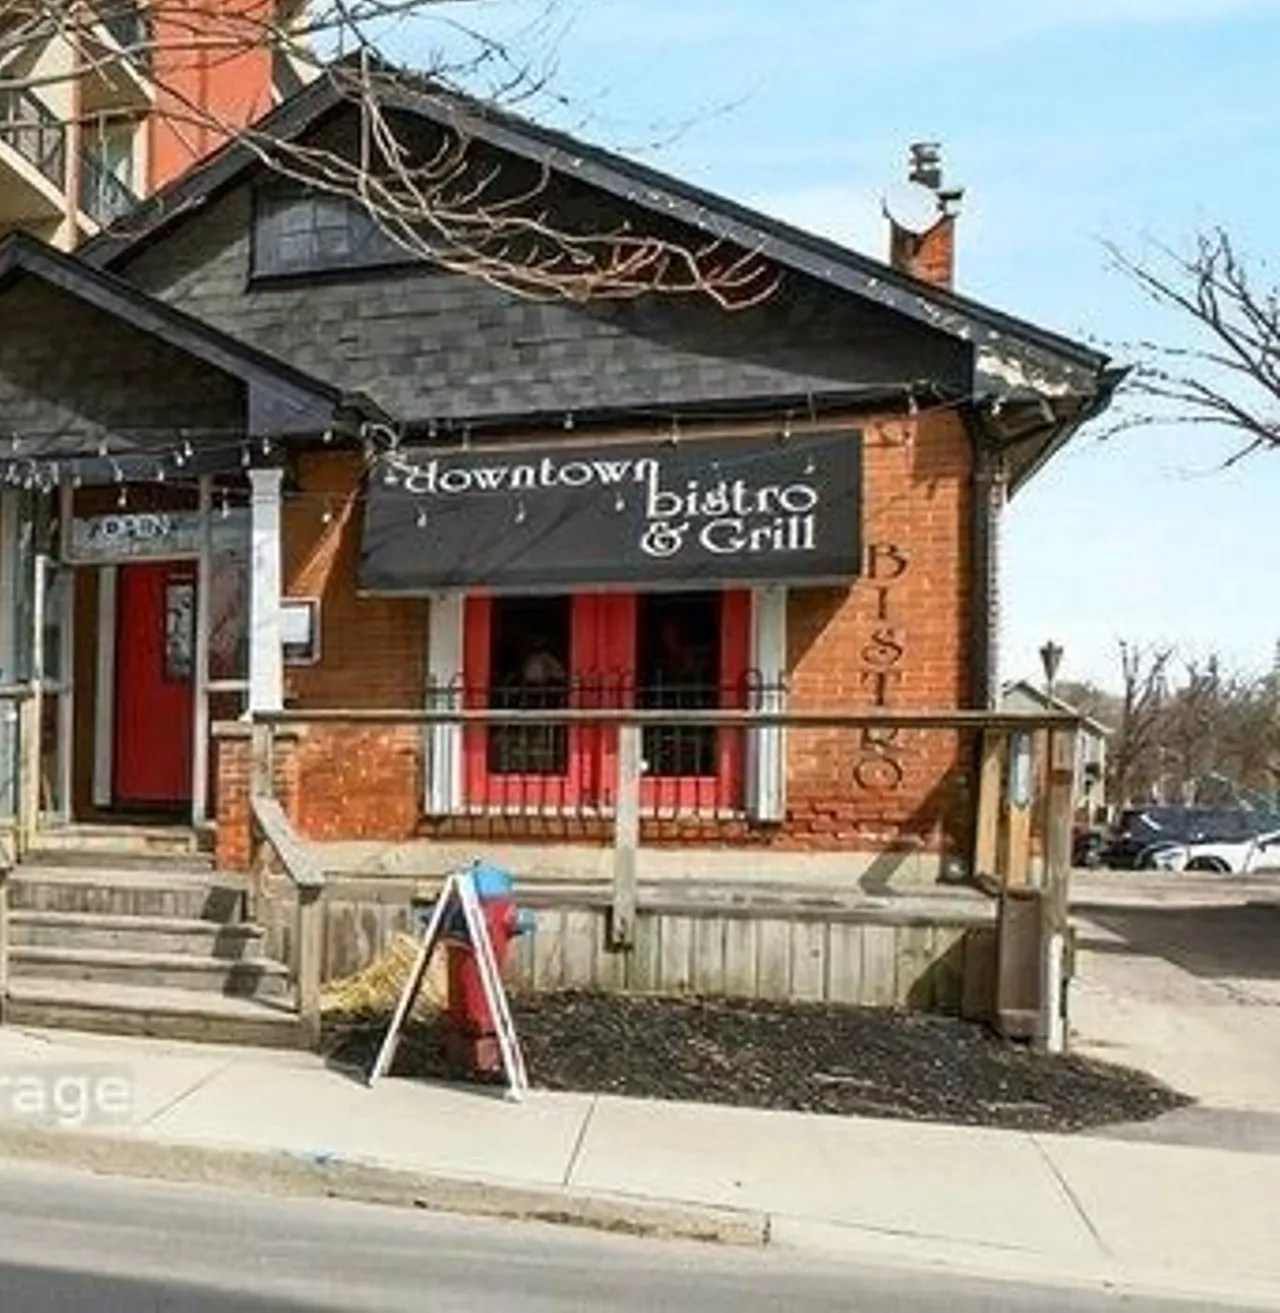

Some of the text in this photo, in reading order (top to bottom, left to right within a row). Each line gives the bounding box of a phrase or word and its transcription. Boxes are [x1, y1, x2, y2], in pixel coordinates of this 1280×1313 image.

[404, 456, 660, 494] downtown
[647, 474, 819, 519] bistro
[640, 517, 818, 557] & Grill
